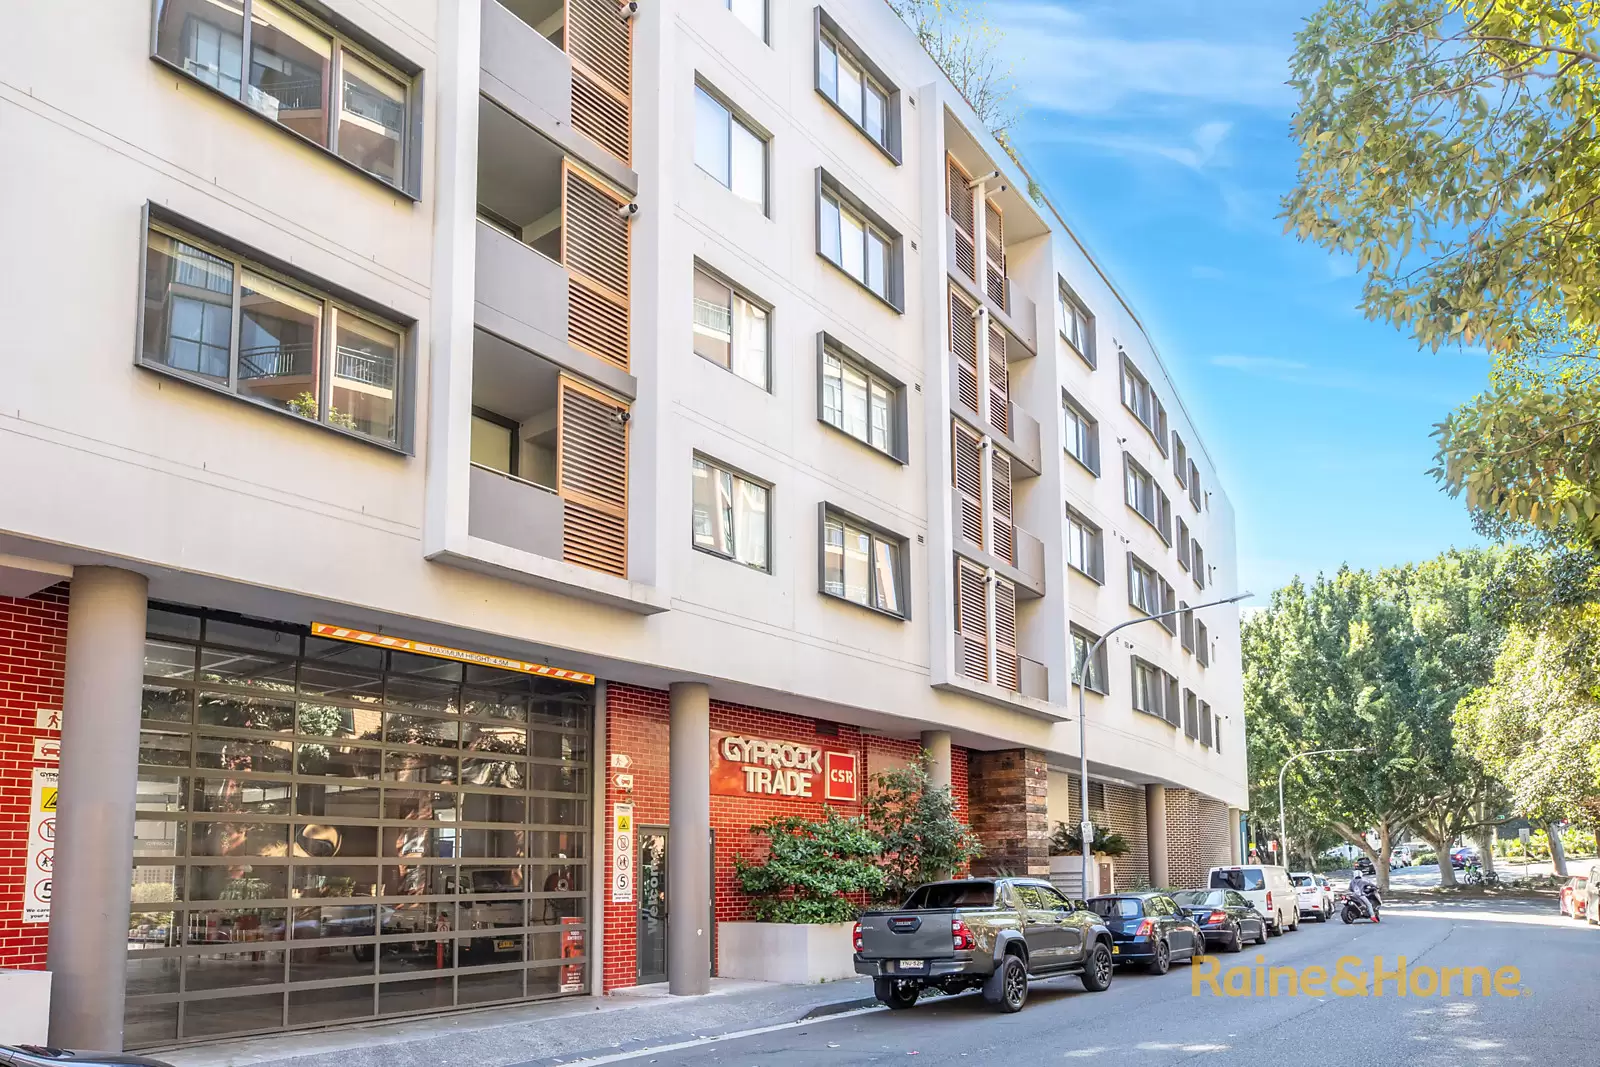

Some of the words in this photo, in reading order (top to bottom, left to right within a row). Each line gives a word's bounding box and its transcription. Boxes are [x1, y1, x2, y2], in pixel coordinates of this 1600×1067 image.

[429, 646, 464, 657] MAXIMUM
[721, 736, 822, 774] GYPROCK
[742, 766, 813, 797] TRADE
[831, 769, 853, 783] CSR
[619, 876, 626, 887] 5
